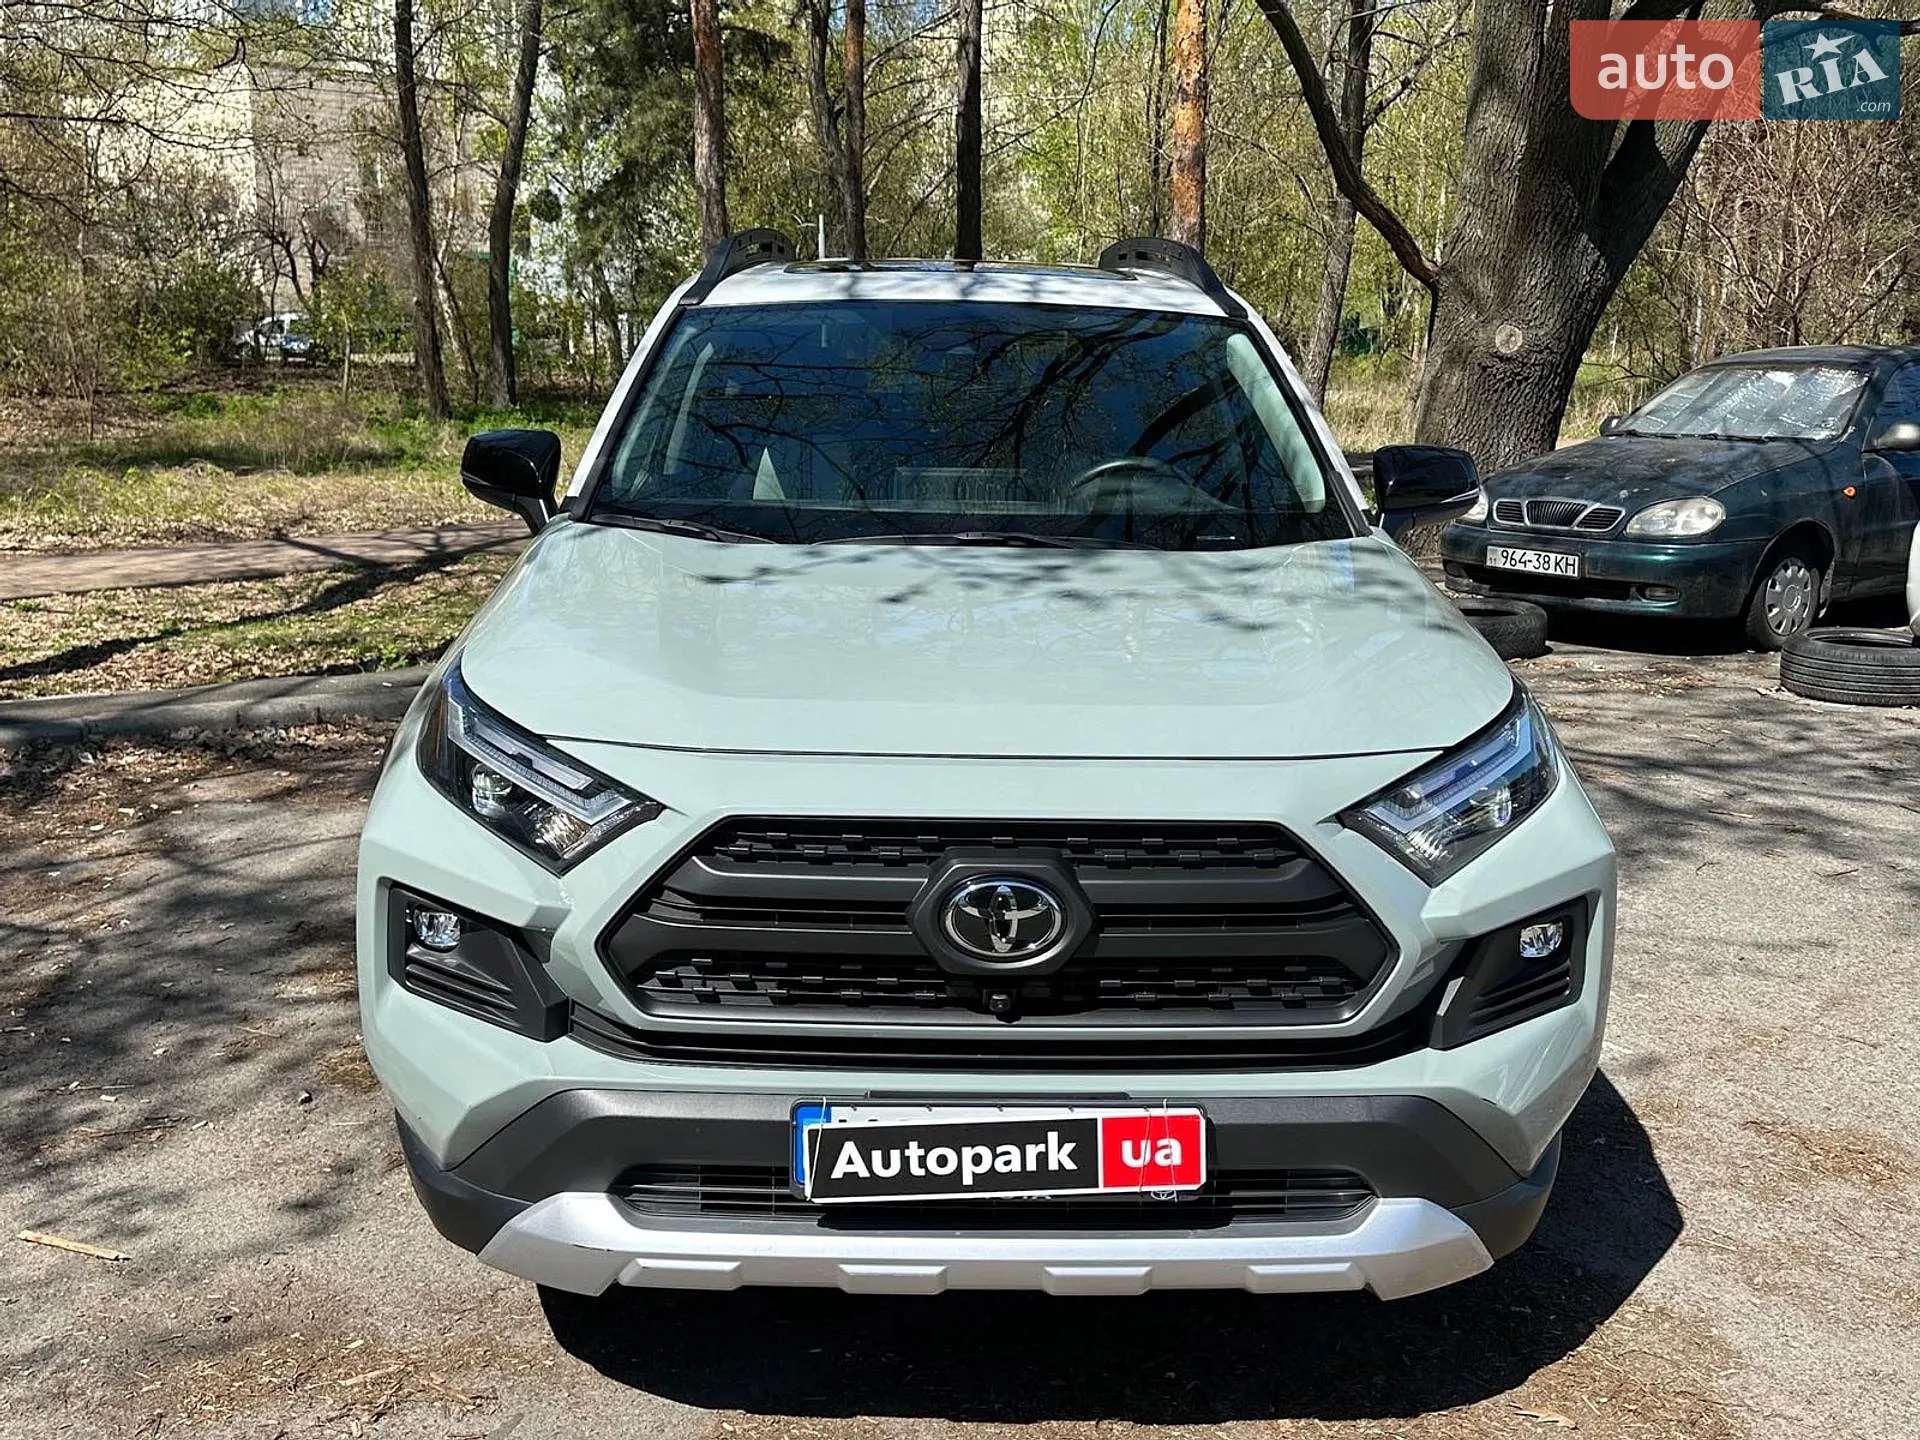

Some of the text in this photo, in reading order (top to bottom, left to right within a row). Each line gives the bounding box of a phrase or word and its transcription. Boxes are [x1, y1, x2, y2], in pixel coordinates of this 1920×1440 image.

[1501, 549, 1551, 571] 964-38
[1554, 555, 1576, 575] KH
[830, 1131, 1183, 1186] Autopark ua
